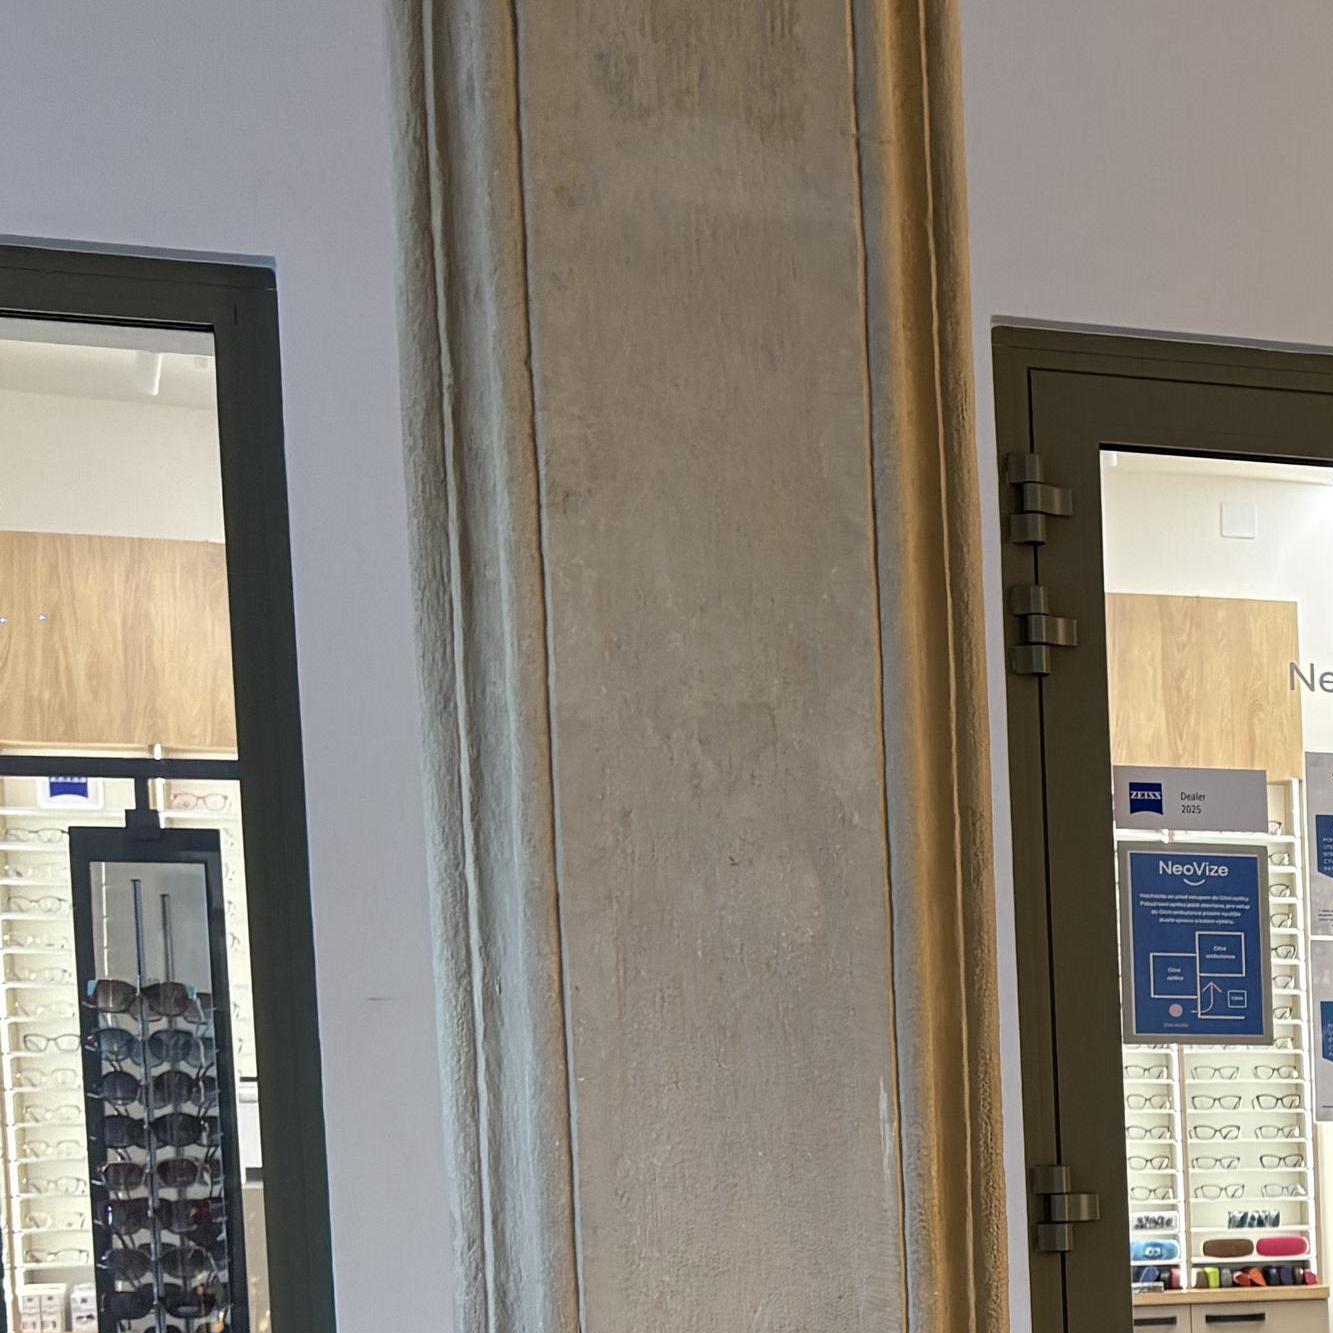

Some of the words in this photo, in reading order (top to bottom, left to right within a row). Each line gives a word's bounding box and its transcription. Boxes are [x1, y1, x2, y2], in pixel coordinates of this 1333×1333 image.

[1131, 791, 1161, 799] ZEISS
[1181, 792, 1205, 801] Dealer
[1181, 805, 1201, 814] 2025
[1159, 861, 1228, 876] NeoVize
